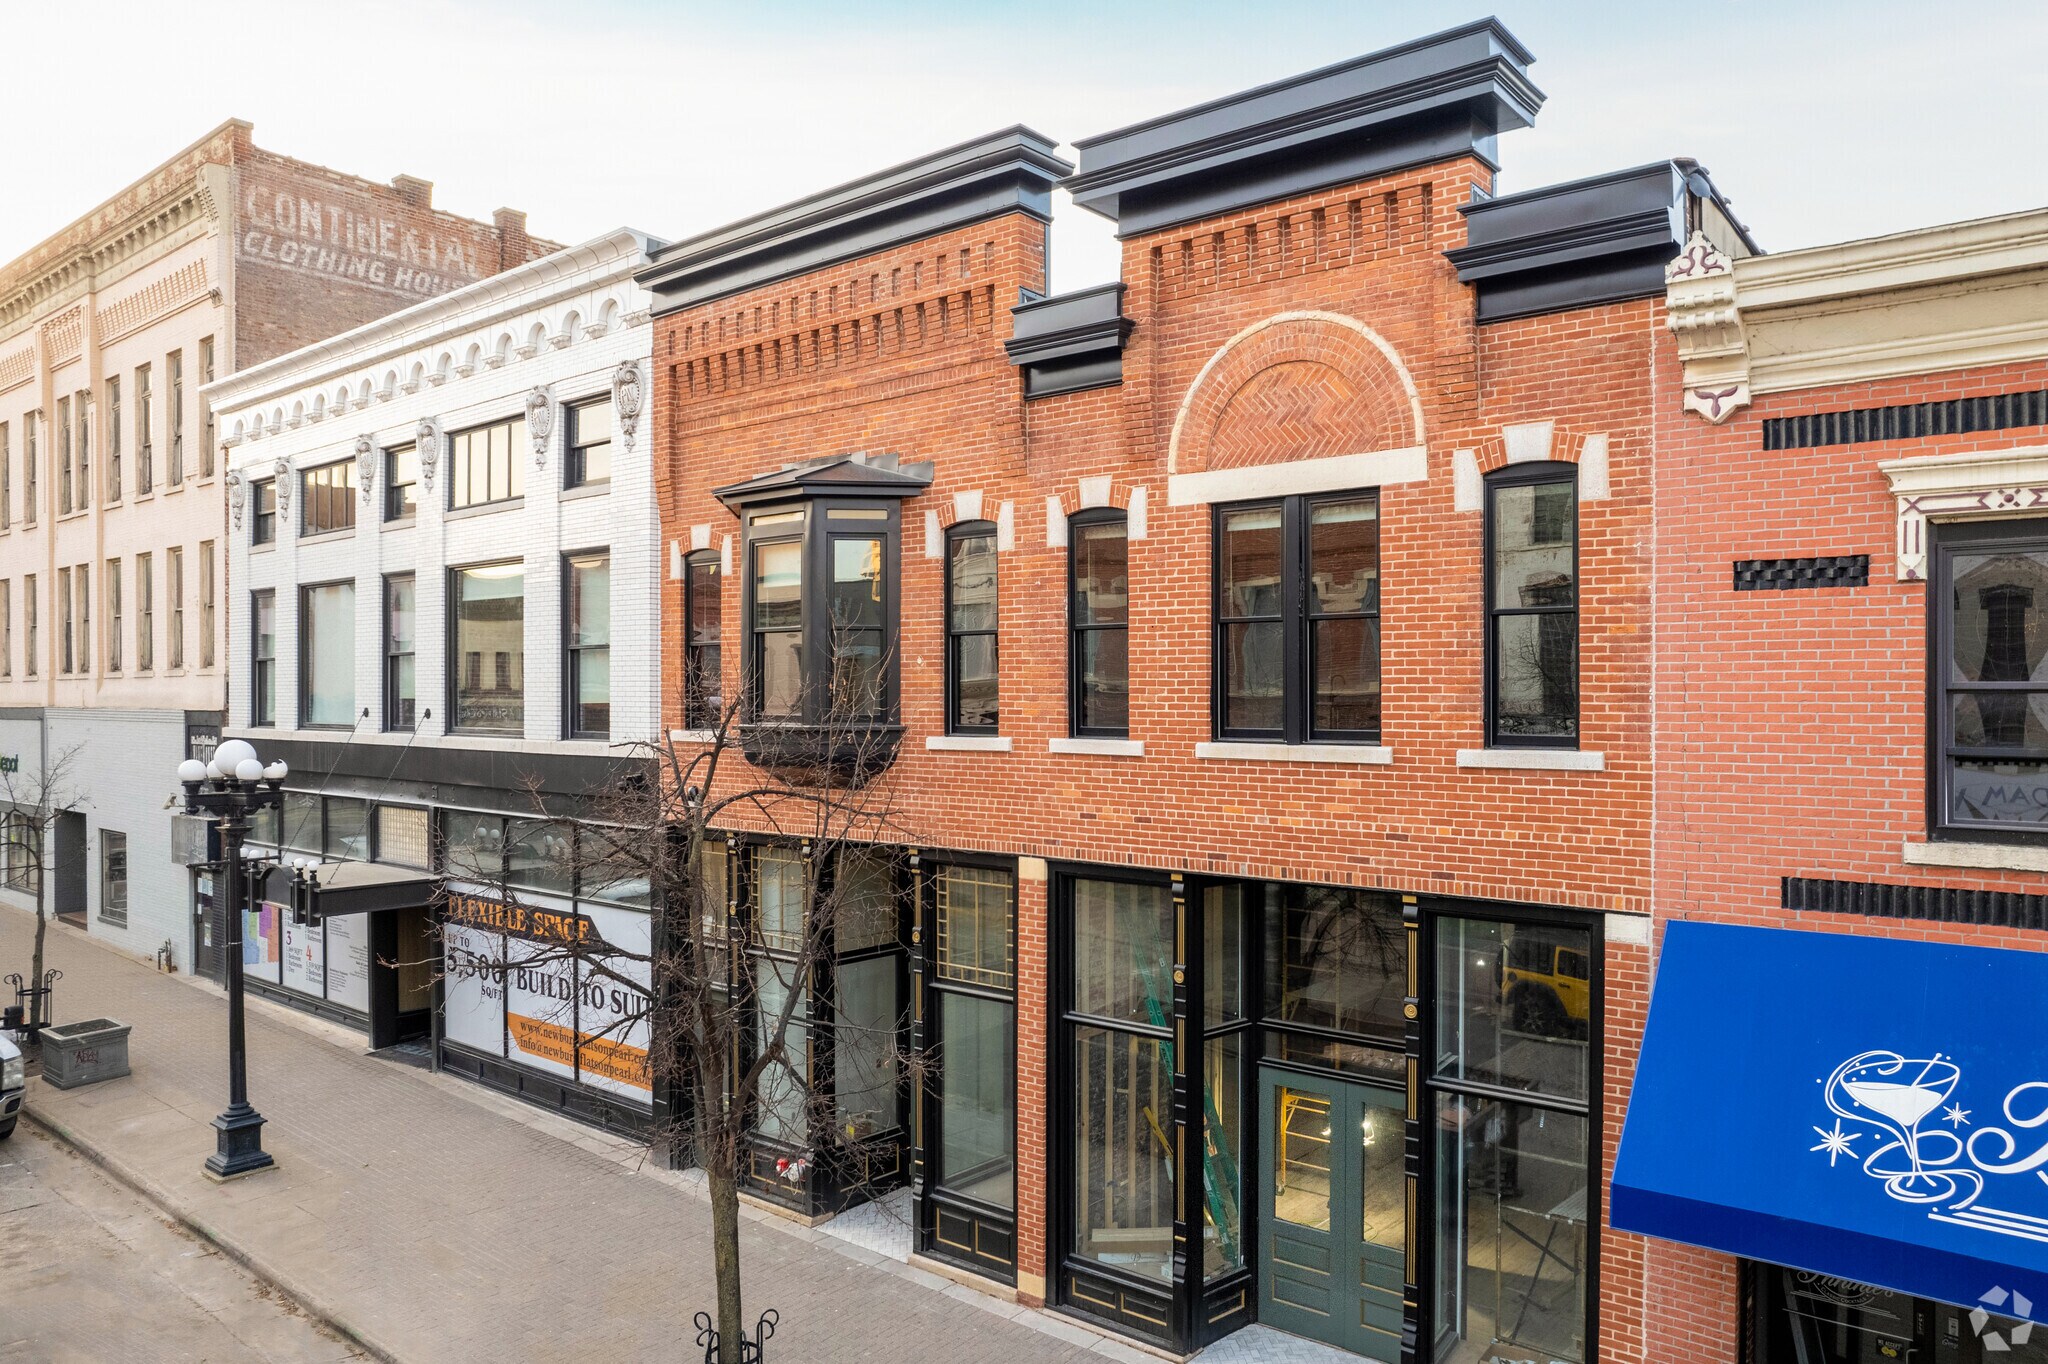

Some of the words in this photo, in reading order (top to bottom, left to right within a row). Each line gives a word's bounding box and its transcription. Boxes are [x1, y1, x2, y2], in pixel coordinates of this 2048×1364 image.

[248, 186, 485, 279] CONTINENTAL
[243, 232, 387, 284] CLOTHING
[286, 931, 292, 945] 3
[306, 945, 312, 961] 4
[460, 937, 470, 947] TO
[516, 968, 571, 1001] BUILD
[580, 982, 605, 1009] TO
[610, 990, 652, 1020] SUIT
